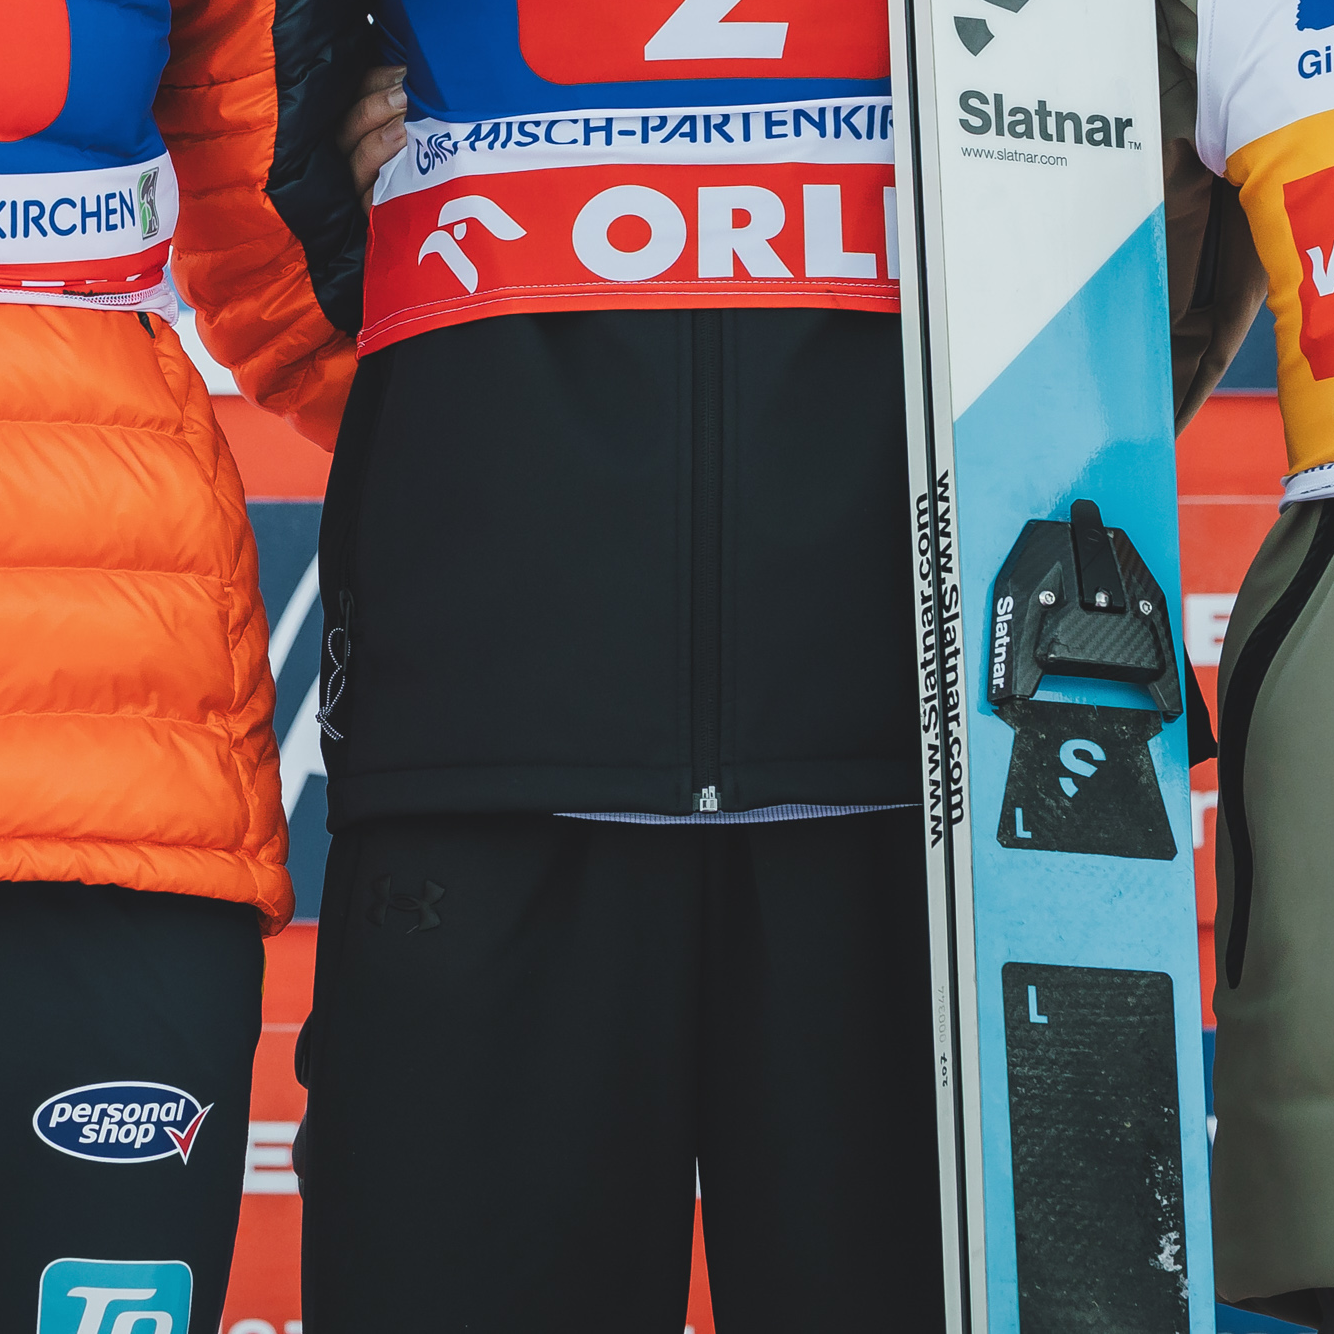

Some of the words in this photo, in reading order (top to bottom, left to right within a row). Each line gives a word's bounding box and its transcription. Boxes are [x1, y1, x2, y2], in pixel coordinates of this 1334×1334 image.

[957, 89, 1134, 149] Slatnar
[961, 145, 1068, 166] www.slatnar.com
[936, 468, 966, 827] www.Slatnar.com
[991, 595, 1014, 690] Slatnar
[915, 492, 944, 849] www.Slatnar.com
[1027, 985, 1049, 1024] L
[48, 1098, 185, 1128] personal
[79, 1120, 156, 1149] shop
